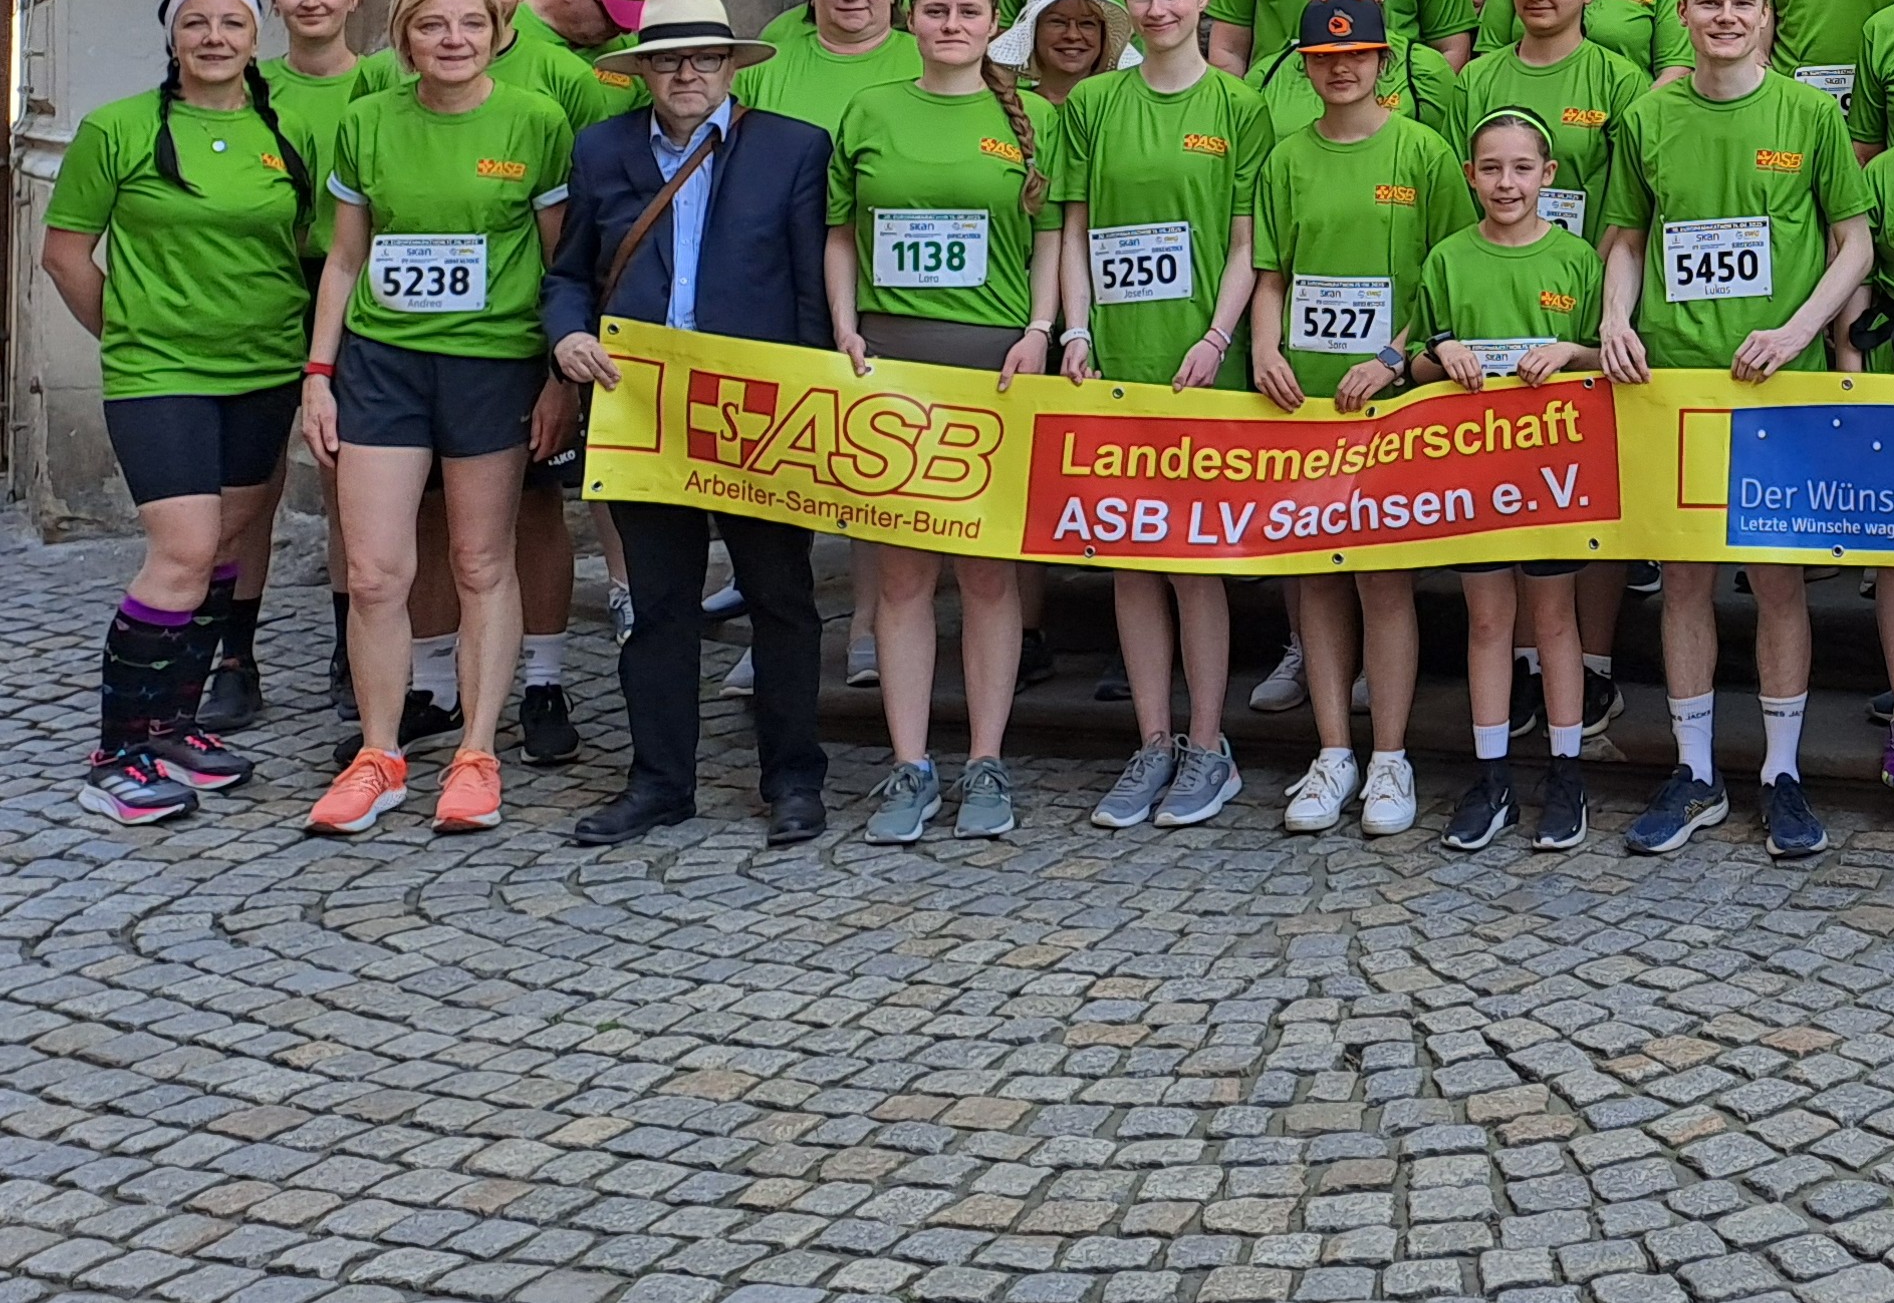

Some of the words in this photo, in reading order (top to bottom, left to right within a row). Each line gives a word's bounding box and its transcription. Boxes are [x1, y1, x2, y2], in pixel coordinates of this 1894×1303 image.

[492, 161, 528, 180] ASB
[1768, 152, 1804, 170] ASB
[1387, 187, 1416, 203] ASB
[1696, 233, 1719, 242] skan
[892, 241, 966, 272] 1138
[1103, 254, 1177, 289] 5250
[1677, 249, 1758, 285] 5450
[383, 266, 470, 296] 5238
[1124, 288, 1153, 299] Josefin
[1704, 284, 1731, 295] Lukas
[407, 299, 442, 308] Andrea
[1304, 307, 1376, 338] 5227
[747, 387, 1004, 501] ASB
[1061, 400, 1583, 482] Landesmeisterschaft
[685, 470, 982, 539] Arbeiter-Samariter-Bund
[1741, 478, 1798, 510] Der
[1053, 496, 1169, 542] ASB
[1187, 500, 1256, 544] LV
[1263, 486, 1474, 541] Sachsen
[1740, 516, 1787, 532] Letzte
[1791, 517, 1861, 535] Wünsche
